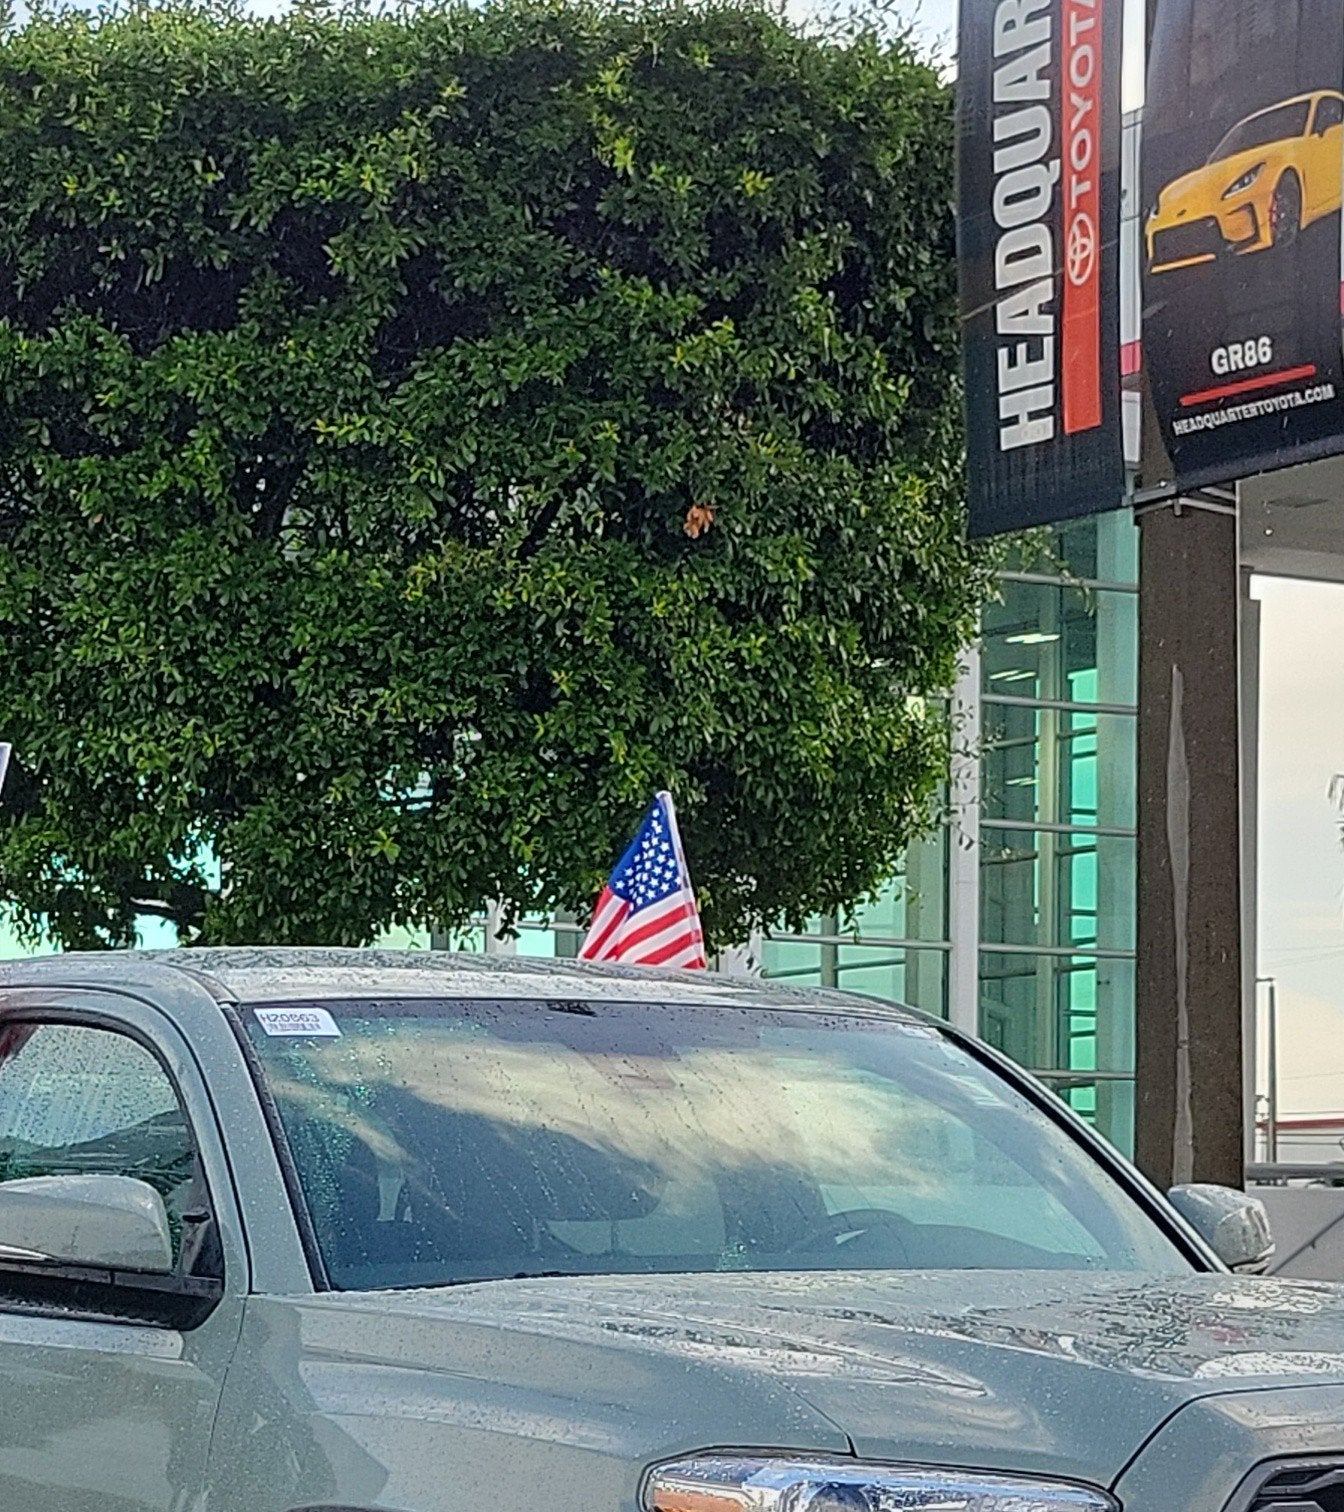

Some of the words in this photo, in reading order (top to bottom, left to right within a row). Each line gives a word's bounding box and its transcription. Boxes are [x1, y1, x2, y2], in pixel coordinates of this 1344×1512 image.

[1069, 0, 1095, 207] TOYOT
[1211, 336, 1272, 375] GR86
[1172, 383, 1336, 436] HEADQUARTERTOYOTA.COM
